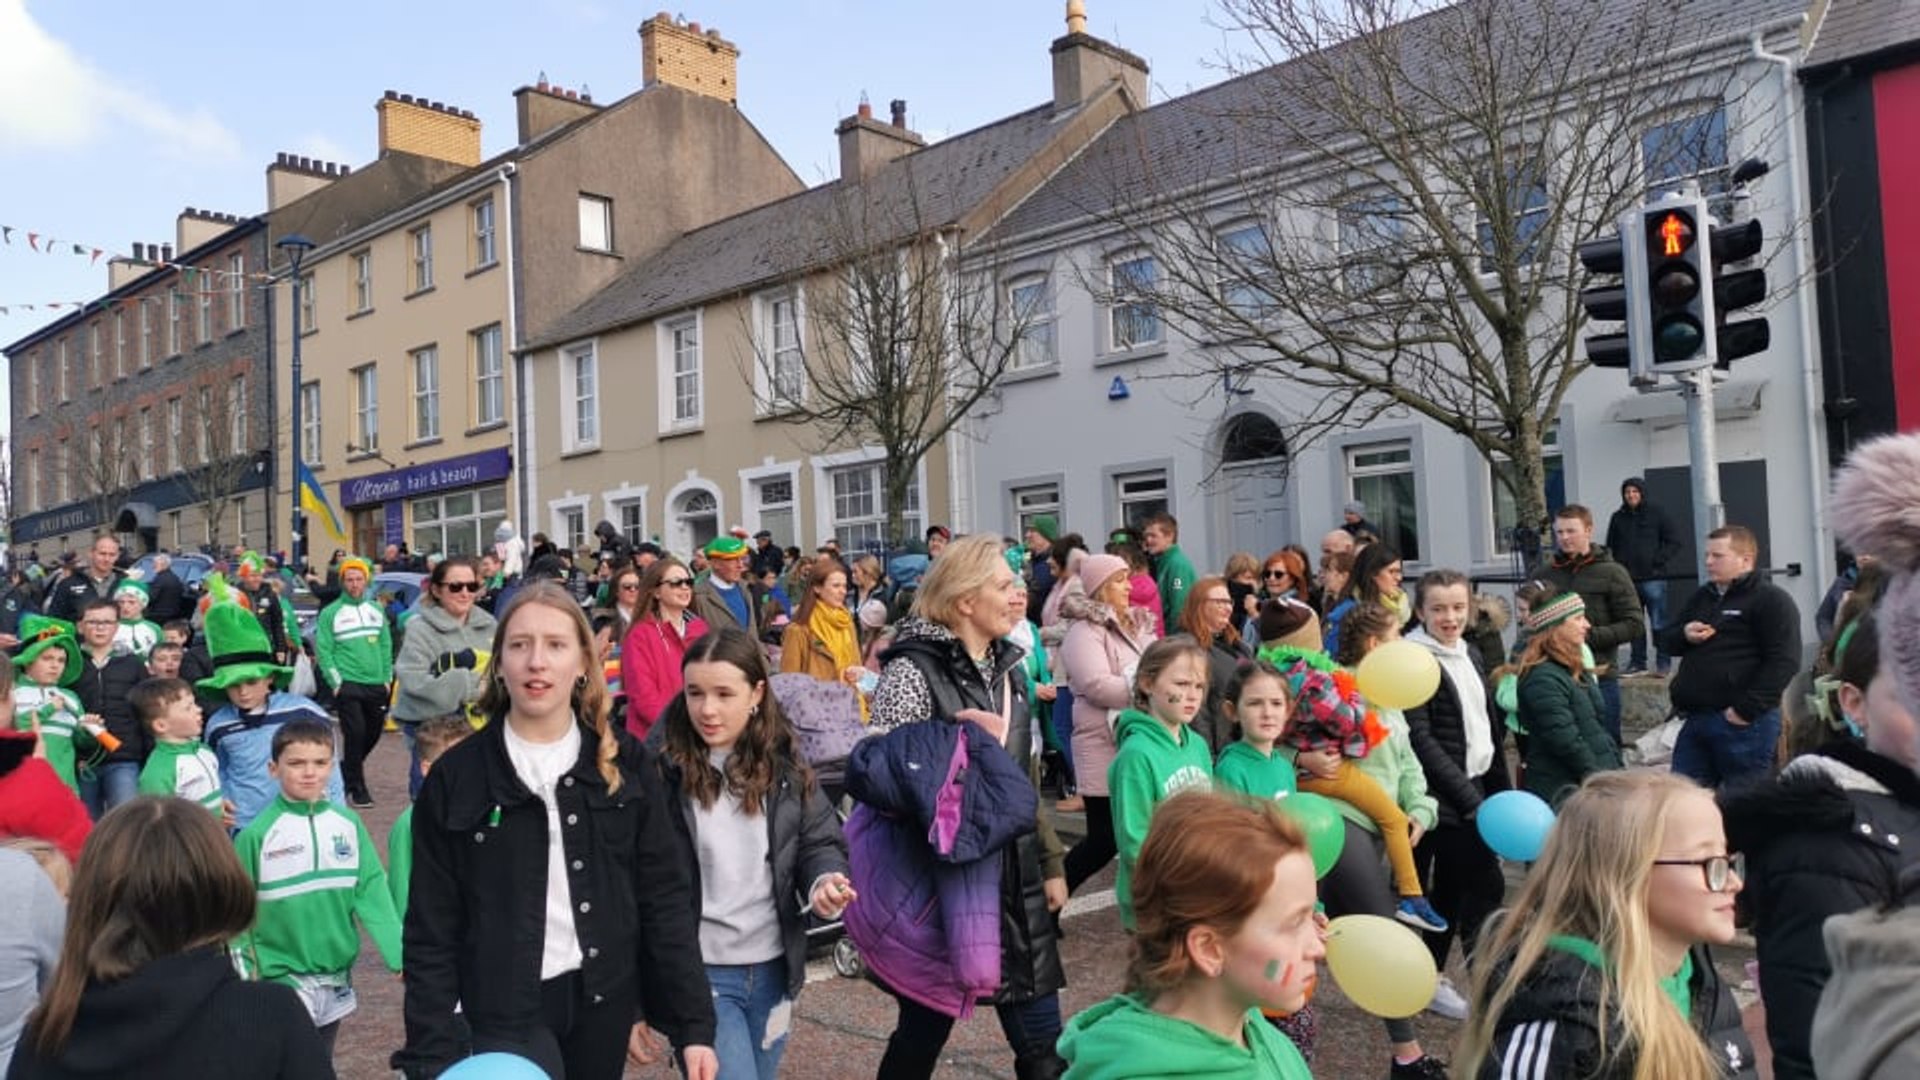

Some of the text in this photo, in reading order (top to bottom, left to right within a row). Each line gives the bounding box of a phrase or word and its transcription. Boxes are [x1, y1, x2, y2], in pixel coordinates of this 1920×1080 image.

[408, 473, 427, 489] hair
[430, 469, 438, 486] &
[440, 465, 478, 483] beauty
